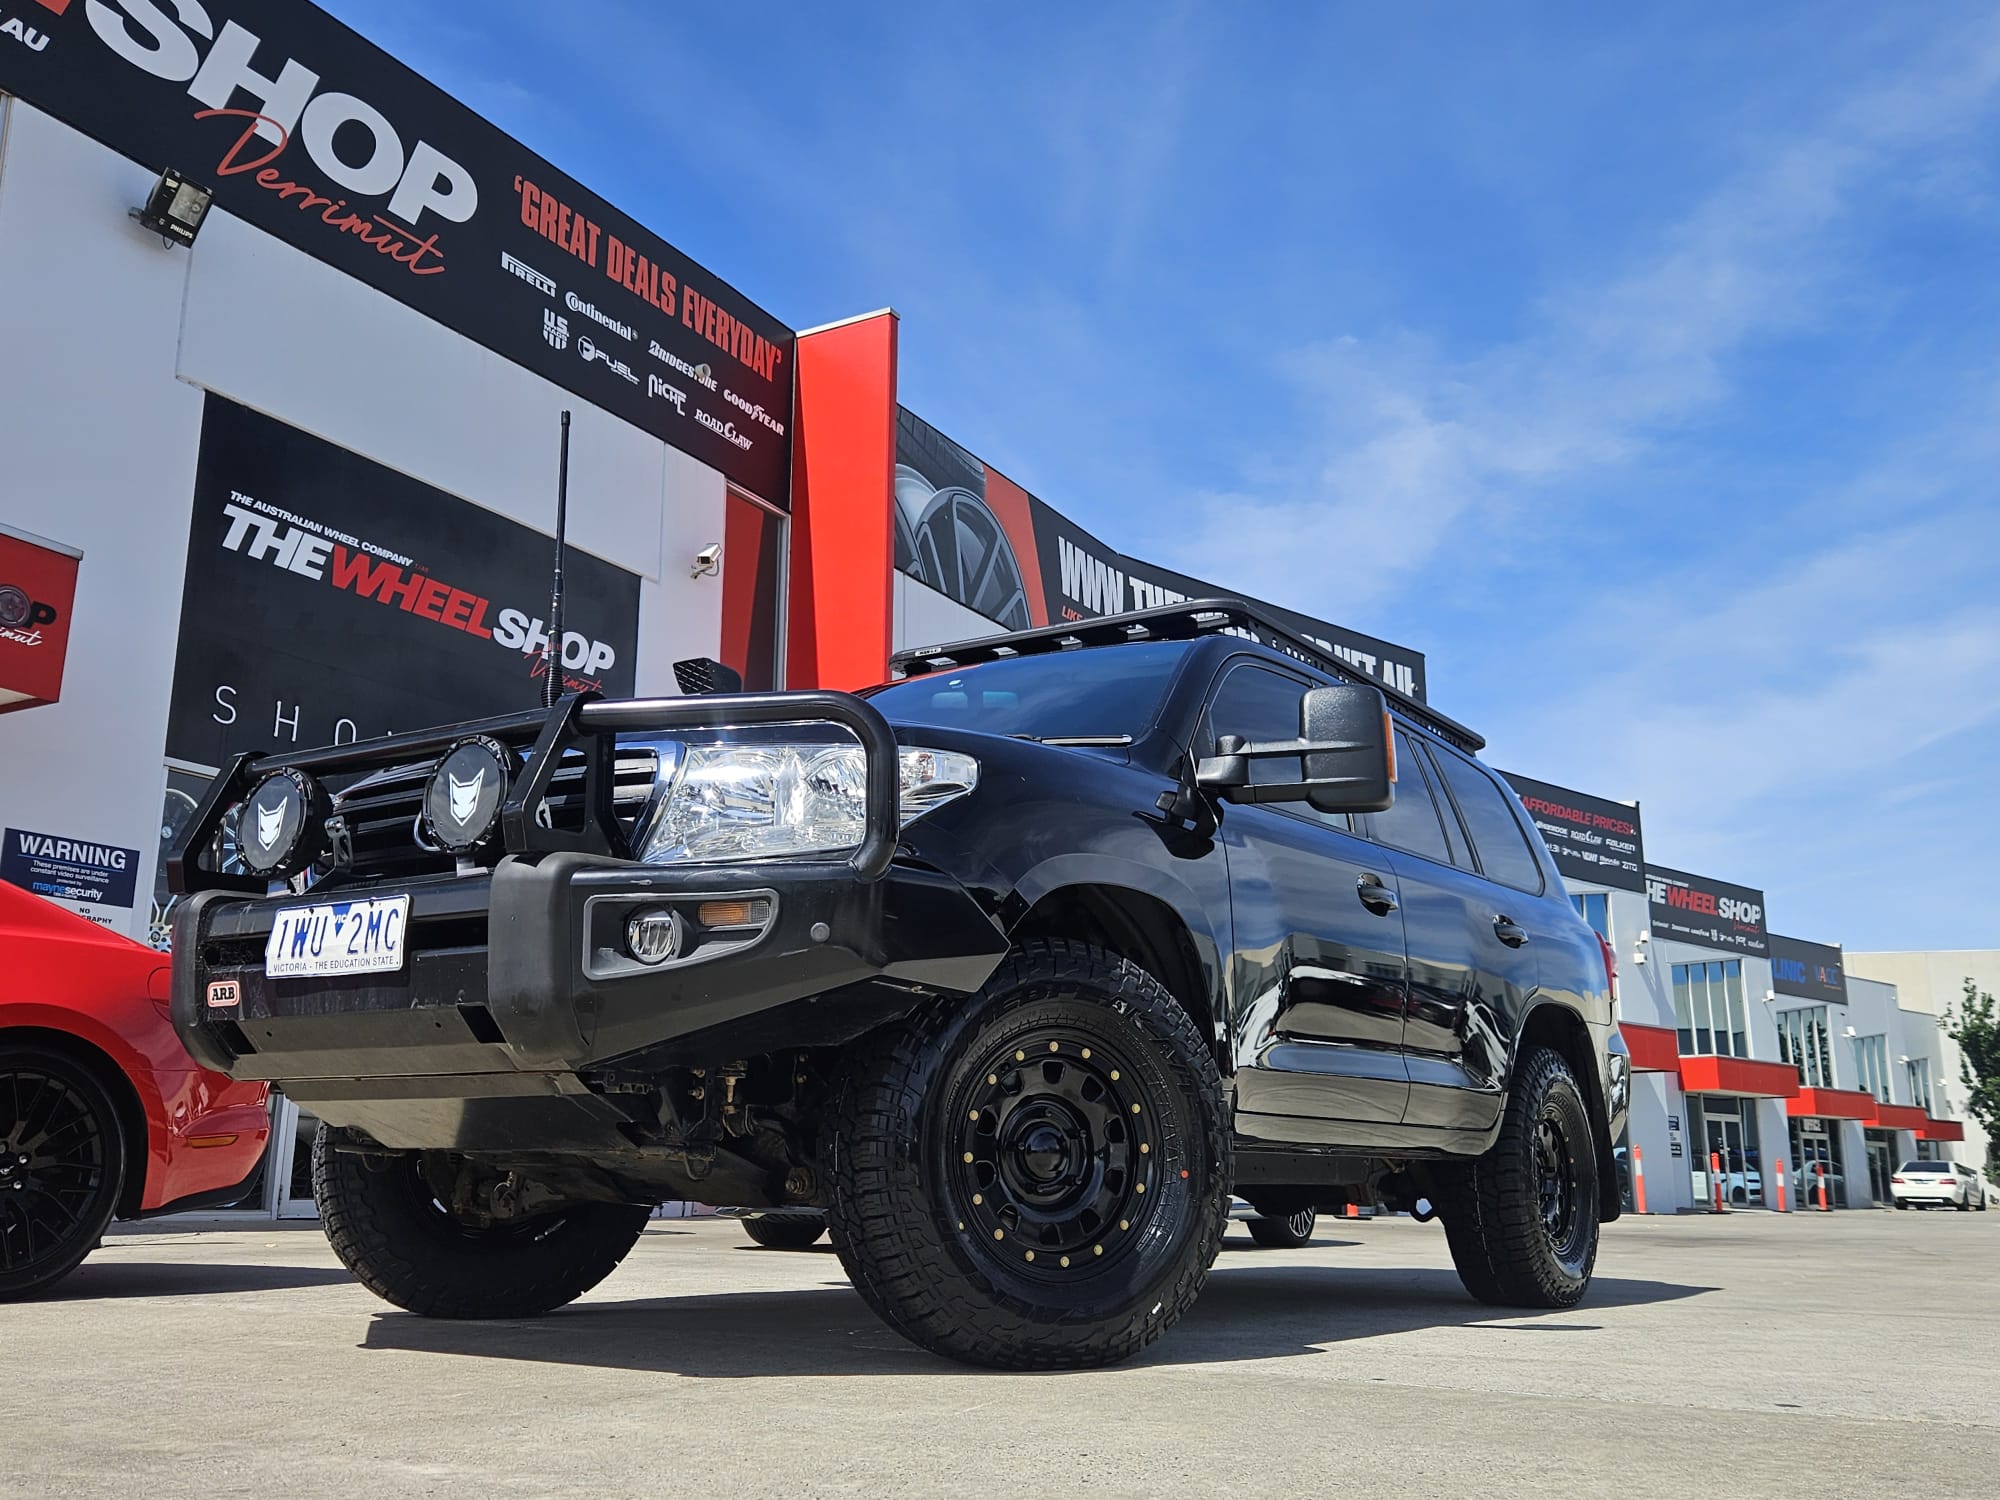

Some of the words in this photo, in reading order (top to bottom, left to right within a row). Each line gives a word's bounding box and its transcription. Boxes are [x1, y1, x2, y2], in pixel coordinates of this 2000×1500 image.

[85, 0, 478, 226] SHOP
[194, 108, 446, 275] Derrimut
[170, 223, 193, 239] PHILIPS
[501, 251, 556, 298] PIRELLI
[606, 234, 677, 317] DEALS
[565, 291, 631, 341] Continental
[723, 389, 784, 436] GOODYEAR
[230, 490, 253, 507] THE
[252, 500, 324, 533] AUSTRALIAN
[324, 526, 360, 548] WHEEL
[361, 541, 413, 567] COMPANY
[222, 503, 335, 580] THE
[333, 543, 493, 640] WHEEL
[493, 608, 616, 676] SHOP
[1522, 795, 1592, 825] AFFORDABLE
[19, 833, 127, 870] WARNING
[30, 867, 57, 876] constant
[33, 860, 52, 868] These
[79, 907, 91, 915] NO
[1667, 885, 1718, 916] WHEEL
[1718, 897, 1762, 924] SHOP
[276, 914, 326, 958] 1WU
[347, 907, 399, 954] 2MC
[273, 963, 307, 973] VICTORIA
[314, 960, 329, 970] THE
[330, 957, 369, 970] EDUCATION
[372, 955, 394, 966] STATE
[212, 986, 235, 1001] ARB
